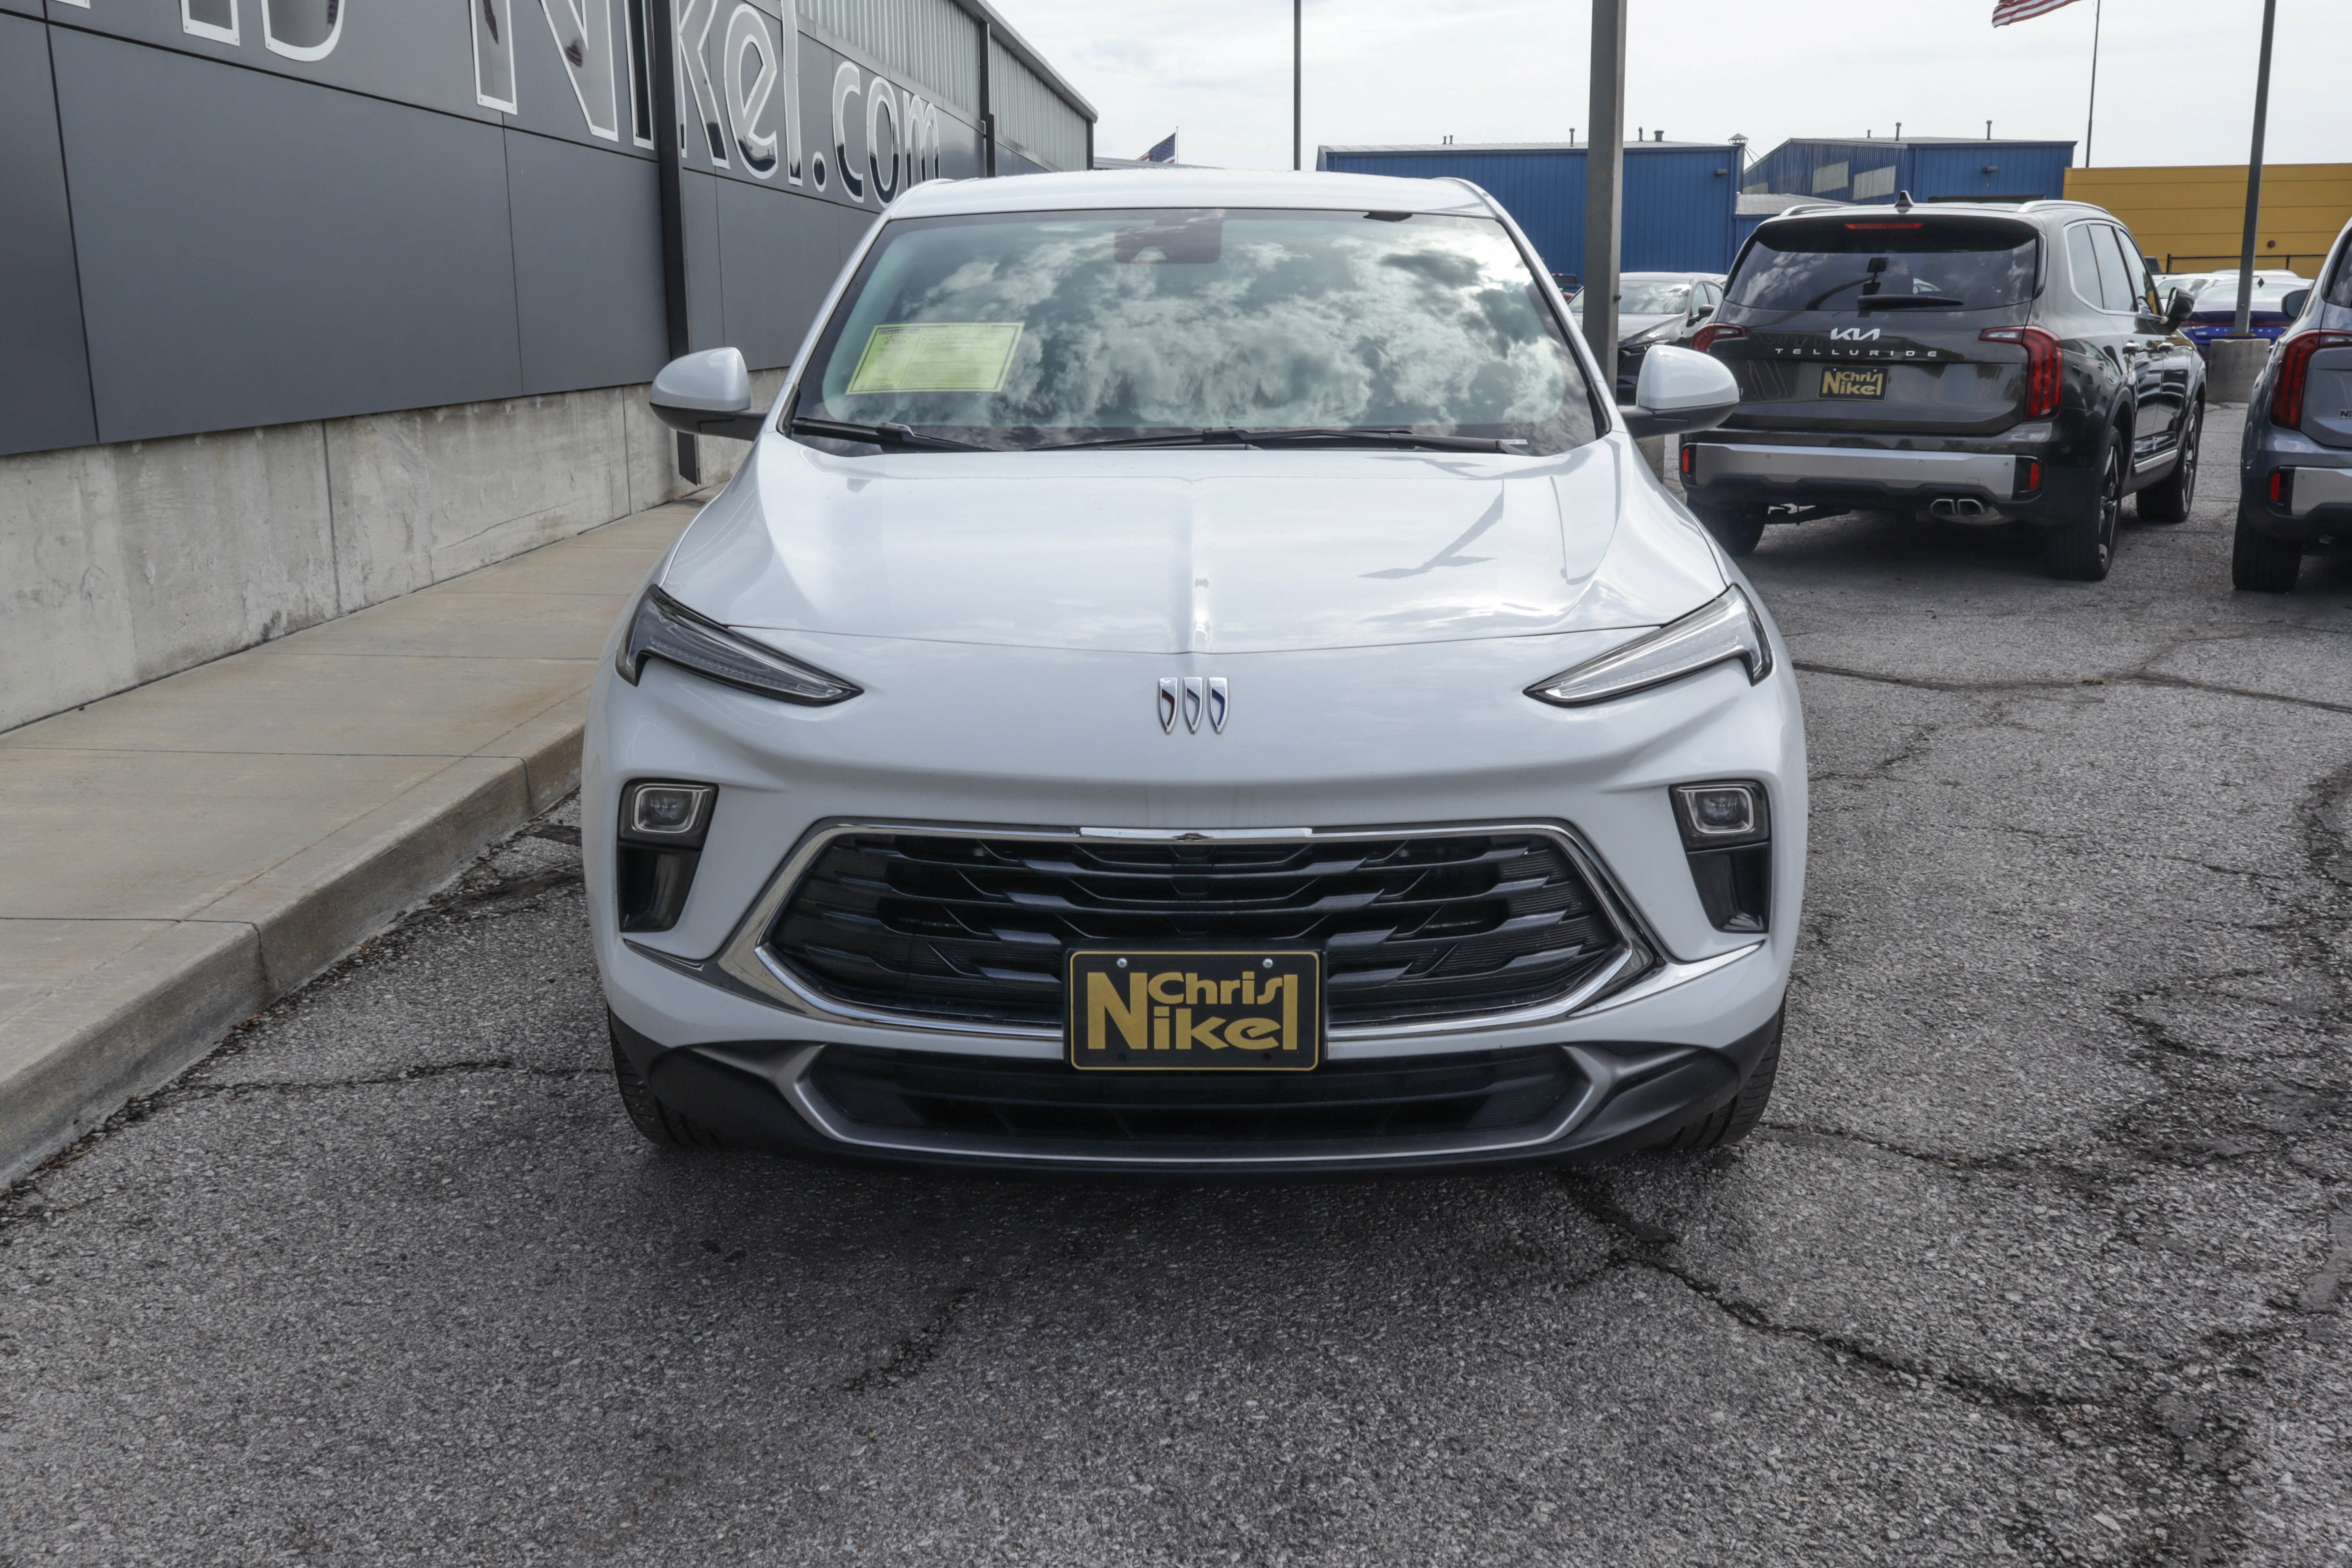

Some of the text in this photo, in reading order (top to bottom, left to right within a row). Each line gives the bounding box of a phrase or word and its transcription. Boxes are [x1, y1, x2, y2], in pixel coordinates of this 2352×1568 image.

[1831, 327, 1881, 341] KIA
[1775, 348, 1937, 357] TELLURIDE
[1822, 371, 1883, 396] Nikel
[1841, 371, 1879, 382] Chris
[1147, 971, 1283, 1004] Chris
[1087, 972, 1298, 1050] Nikel
